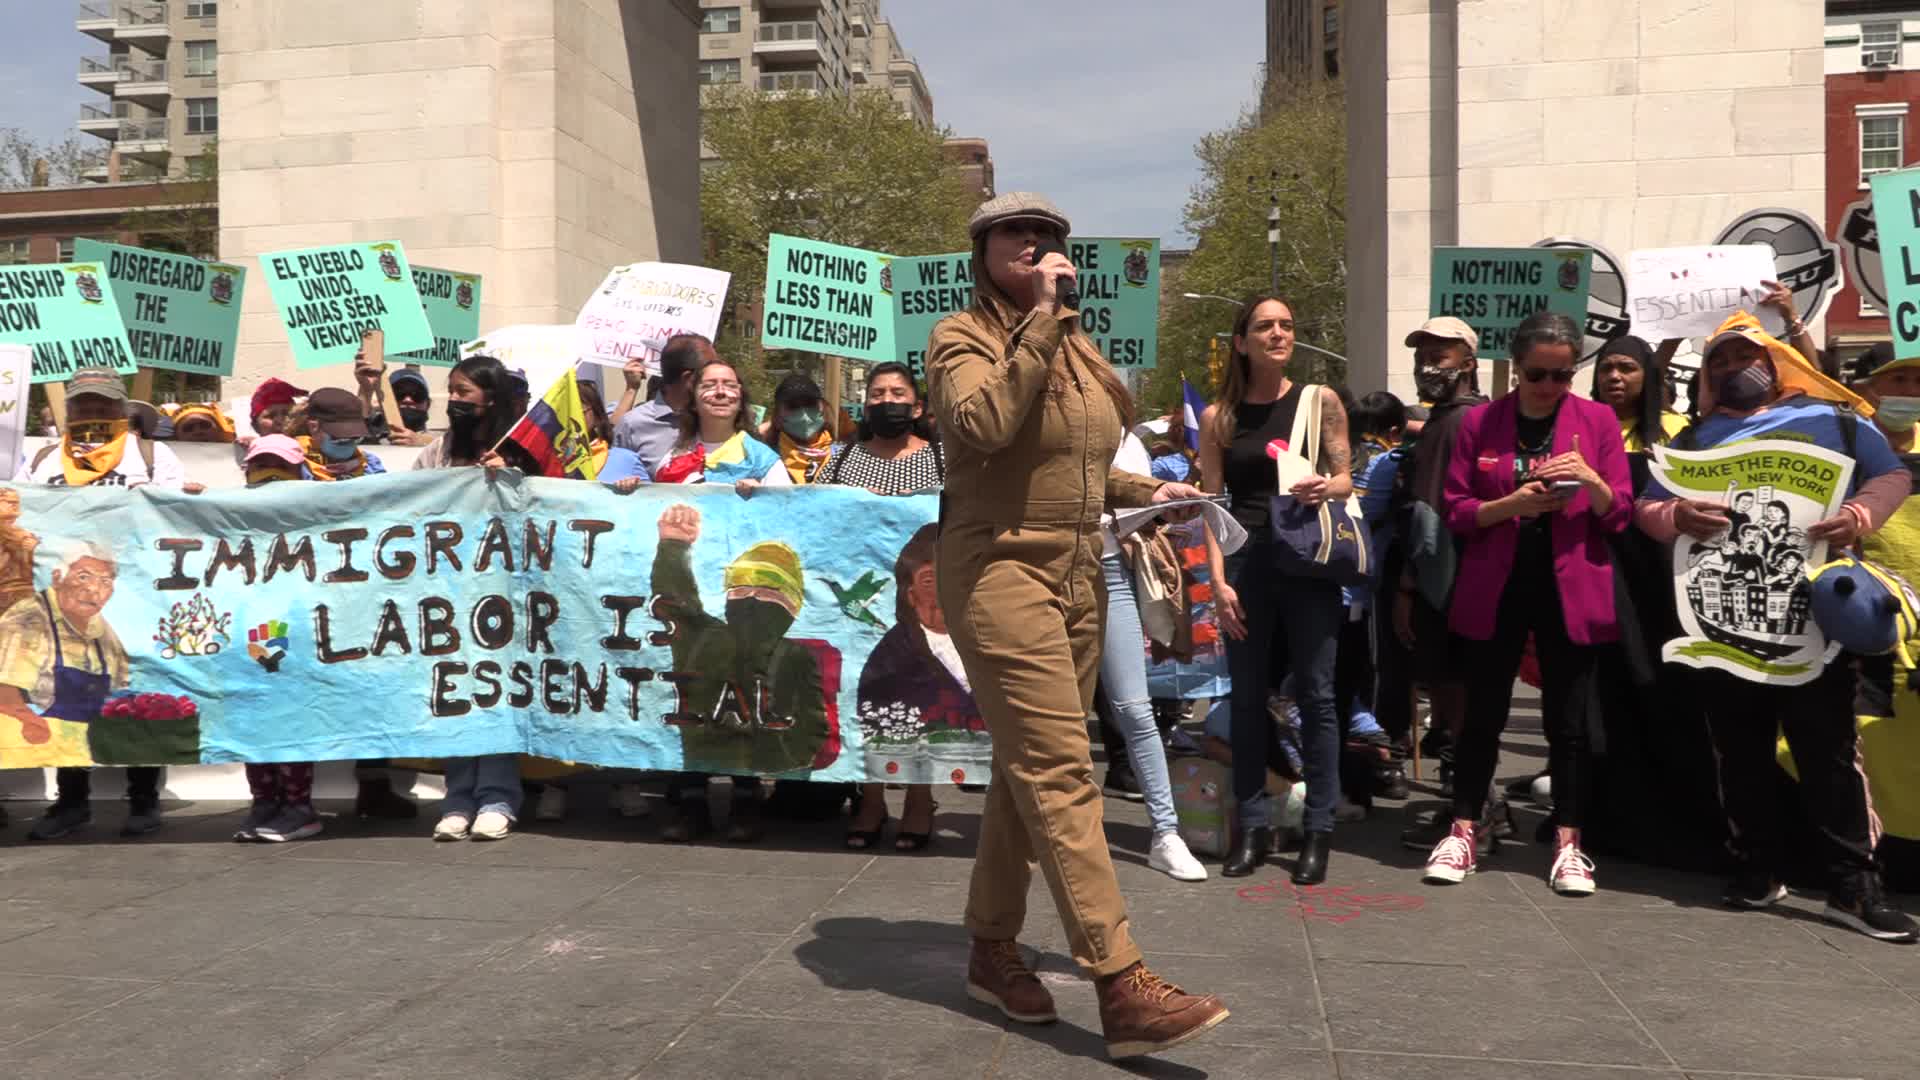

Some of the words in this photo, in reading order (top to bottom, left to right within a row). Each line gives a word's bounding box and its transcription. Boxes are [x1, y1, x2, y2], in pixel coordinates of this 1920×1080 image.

[108, 250, 205, 292] DISREGARD
[272, 258, 298, 280] EL
[298, 249, 364, 277] PUEBLO
[787, 248, 867, 284] NOTHING
[918, 261, 948, 286] WE
[1452, 260, 1542, 285] NOTHING
[298, 274, 359, 301] UNIDO,
[776, 280, 820, 309] LESS
[826, 287, 873, 318] THAN
[135, 292, 168, 323] THE
[287, 298, 343, 329] JAMAS
[1440, 293, 1488, 318] LESS
[1494, 294, 1548, 318] THAN
[766, 311, 878, 351] CITIZENSHIP
[71, 337, 130, 370] AHORA
[1680, 463, 1732, 480] MAKE
[1735, 456, 1774, 472] THE
[1777, 456, 1835, 483] ROAD
[1747, 472, 1782, 484] NEW
[1787, 474, 1829, 497] YORK
[153, 517, 616, 591] IMMIGRANT
[313, 590, 561, 665] LABOR
[600, 592, 684, 651] IS
[430, 658, 797, 730] ESSENTIAL
